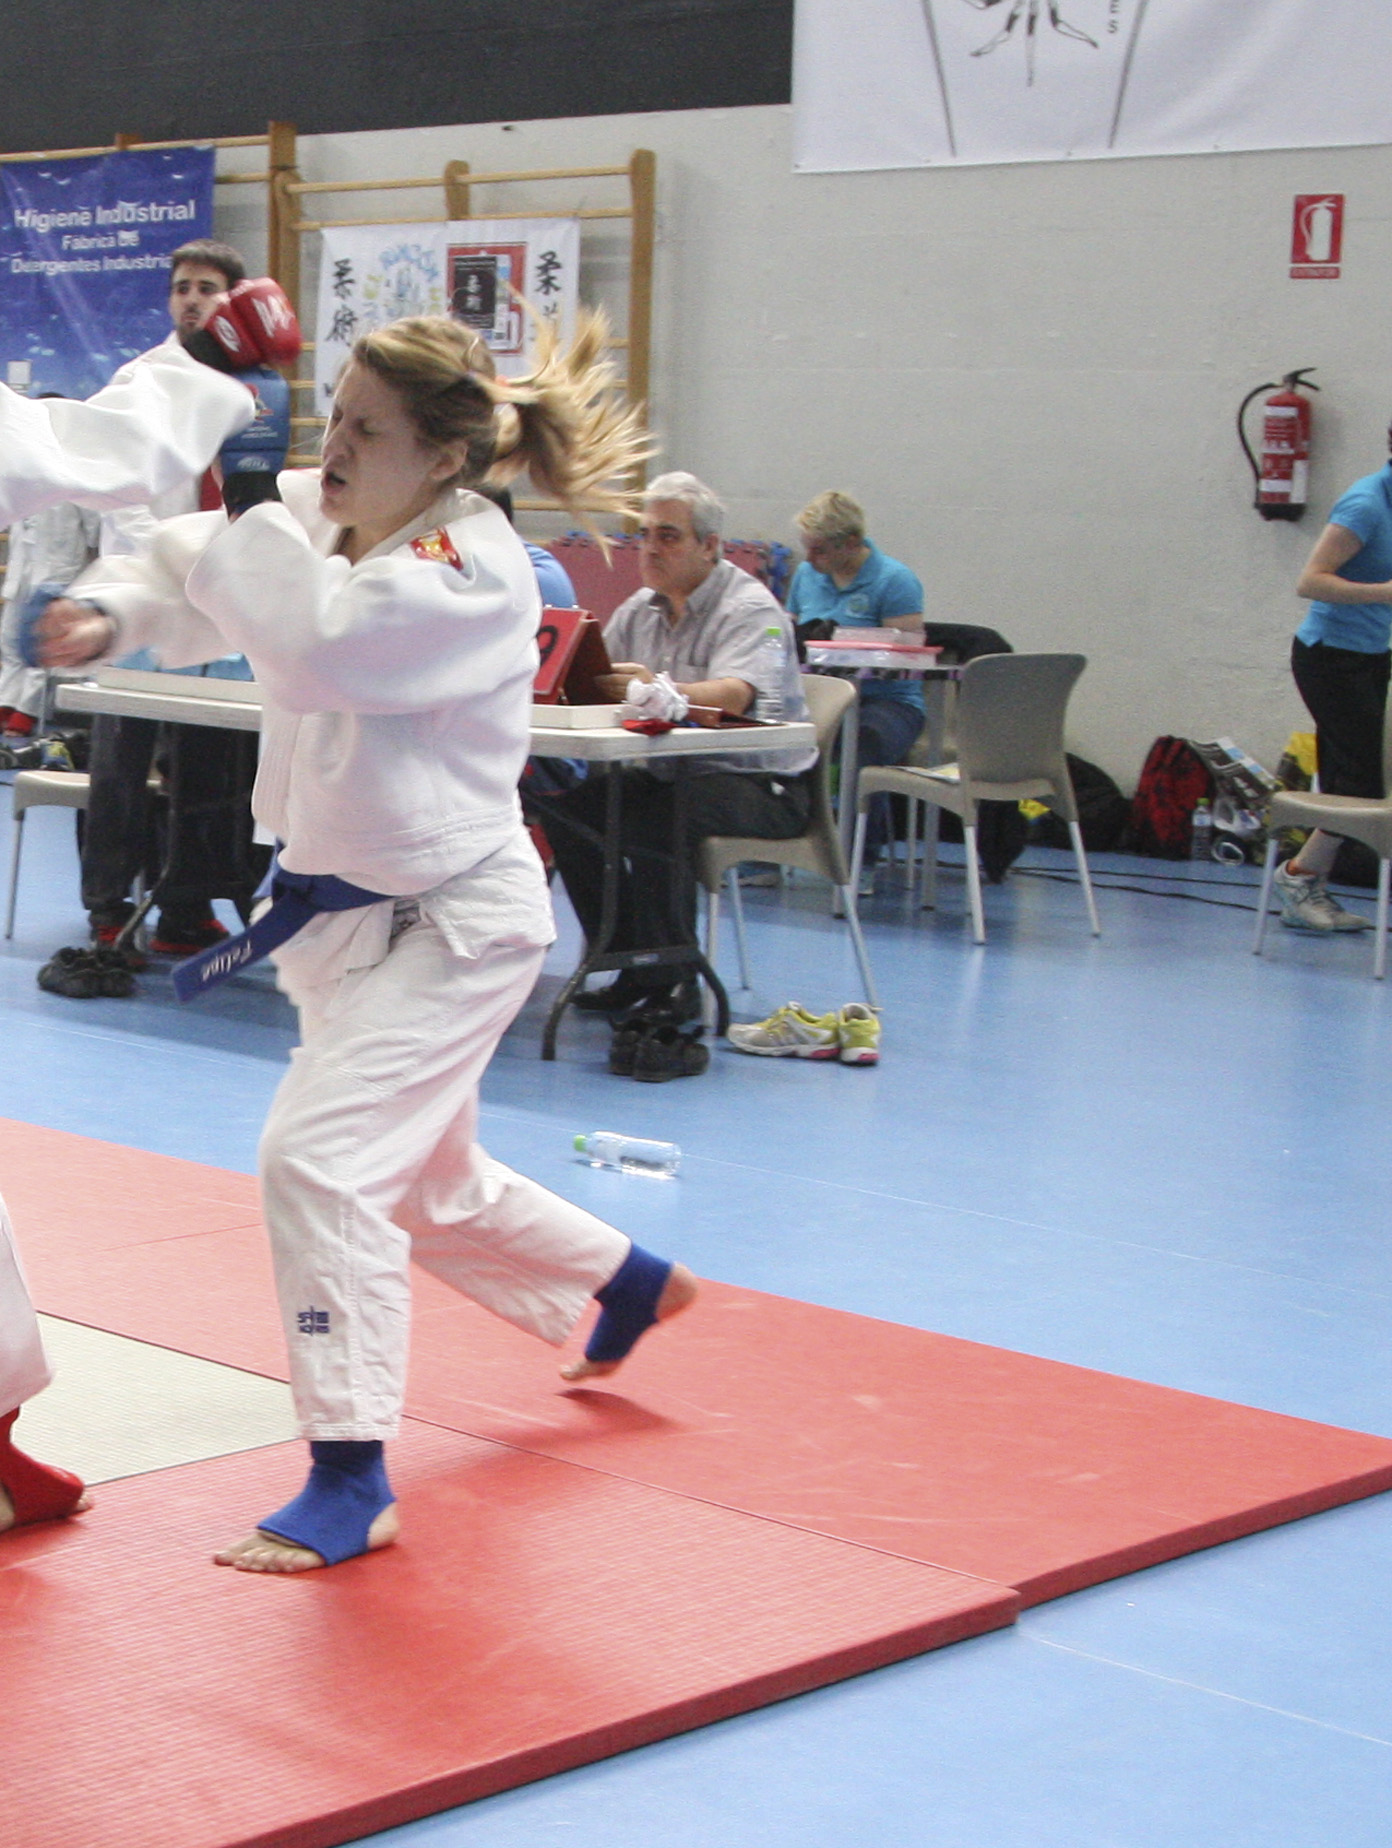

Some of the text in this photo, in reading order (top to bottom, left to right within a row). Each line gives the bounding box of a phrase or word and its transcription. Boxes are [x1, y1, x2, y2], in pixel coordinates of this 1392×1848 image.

[13, 199, 196, 233] Higiene Industrial
[102, 253, 173, 271] Industria
